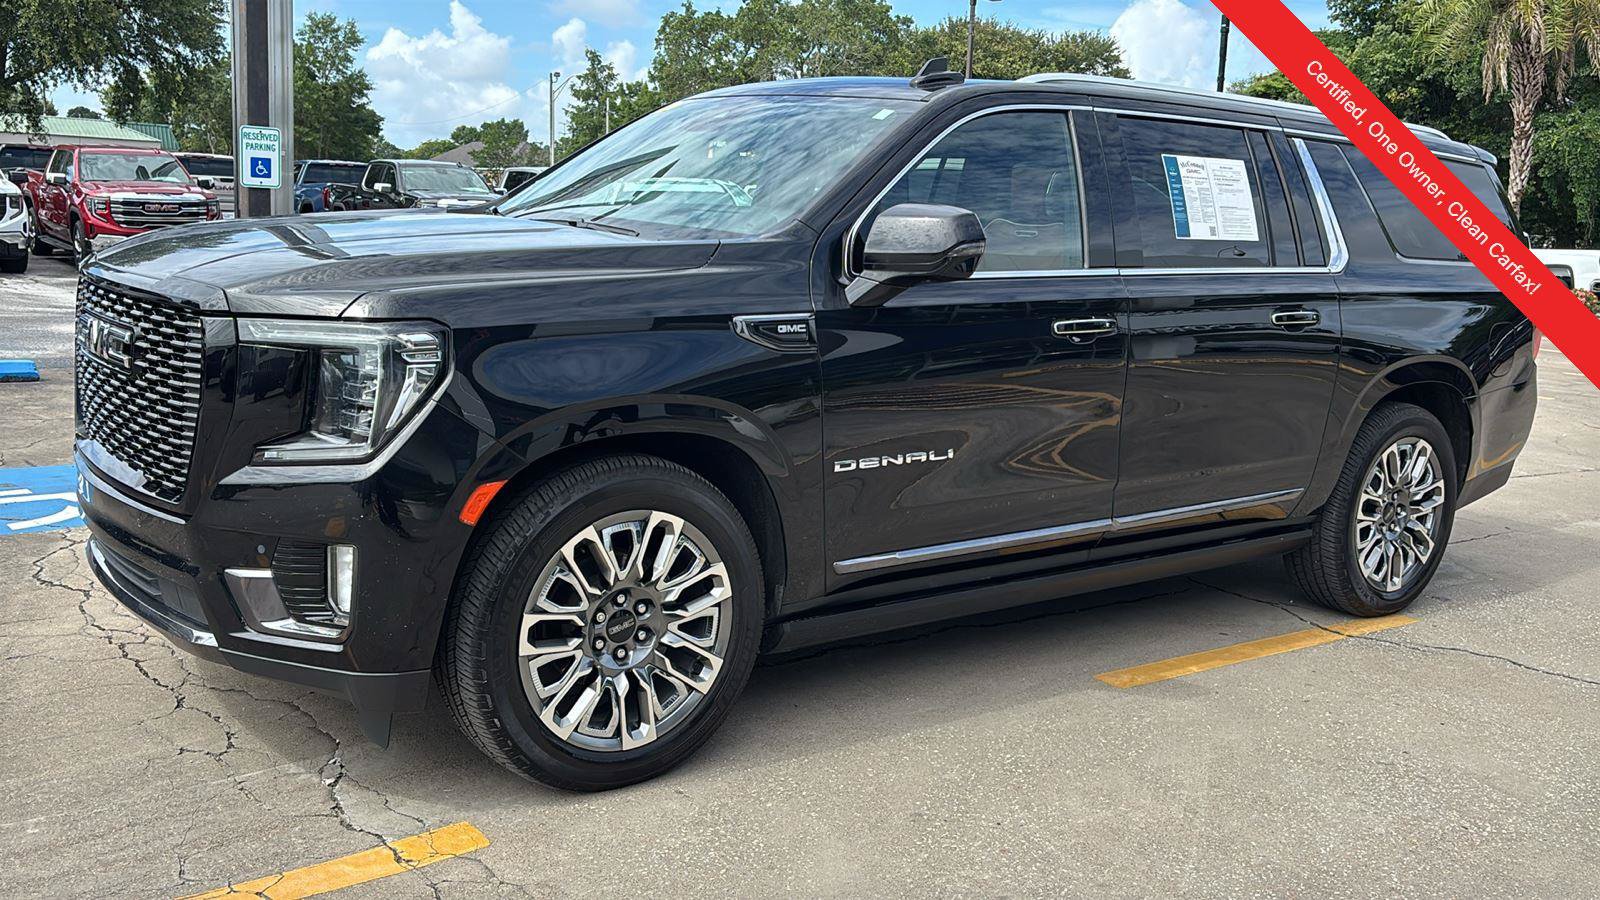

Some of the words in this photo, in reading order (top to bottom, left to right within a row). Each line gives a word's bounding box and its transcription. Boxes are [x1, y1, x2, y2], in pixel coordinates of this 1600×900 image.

[243, 131, 279, 142] RESERVED
[245, 142, 276, 152] PARKING
[145, 204, 179, 212] GMC
[777, 324, 807, 333] GMC
[834, 448, 954, 473] DENALI
